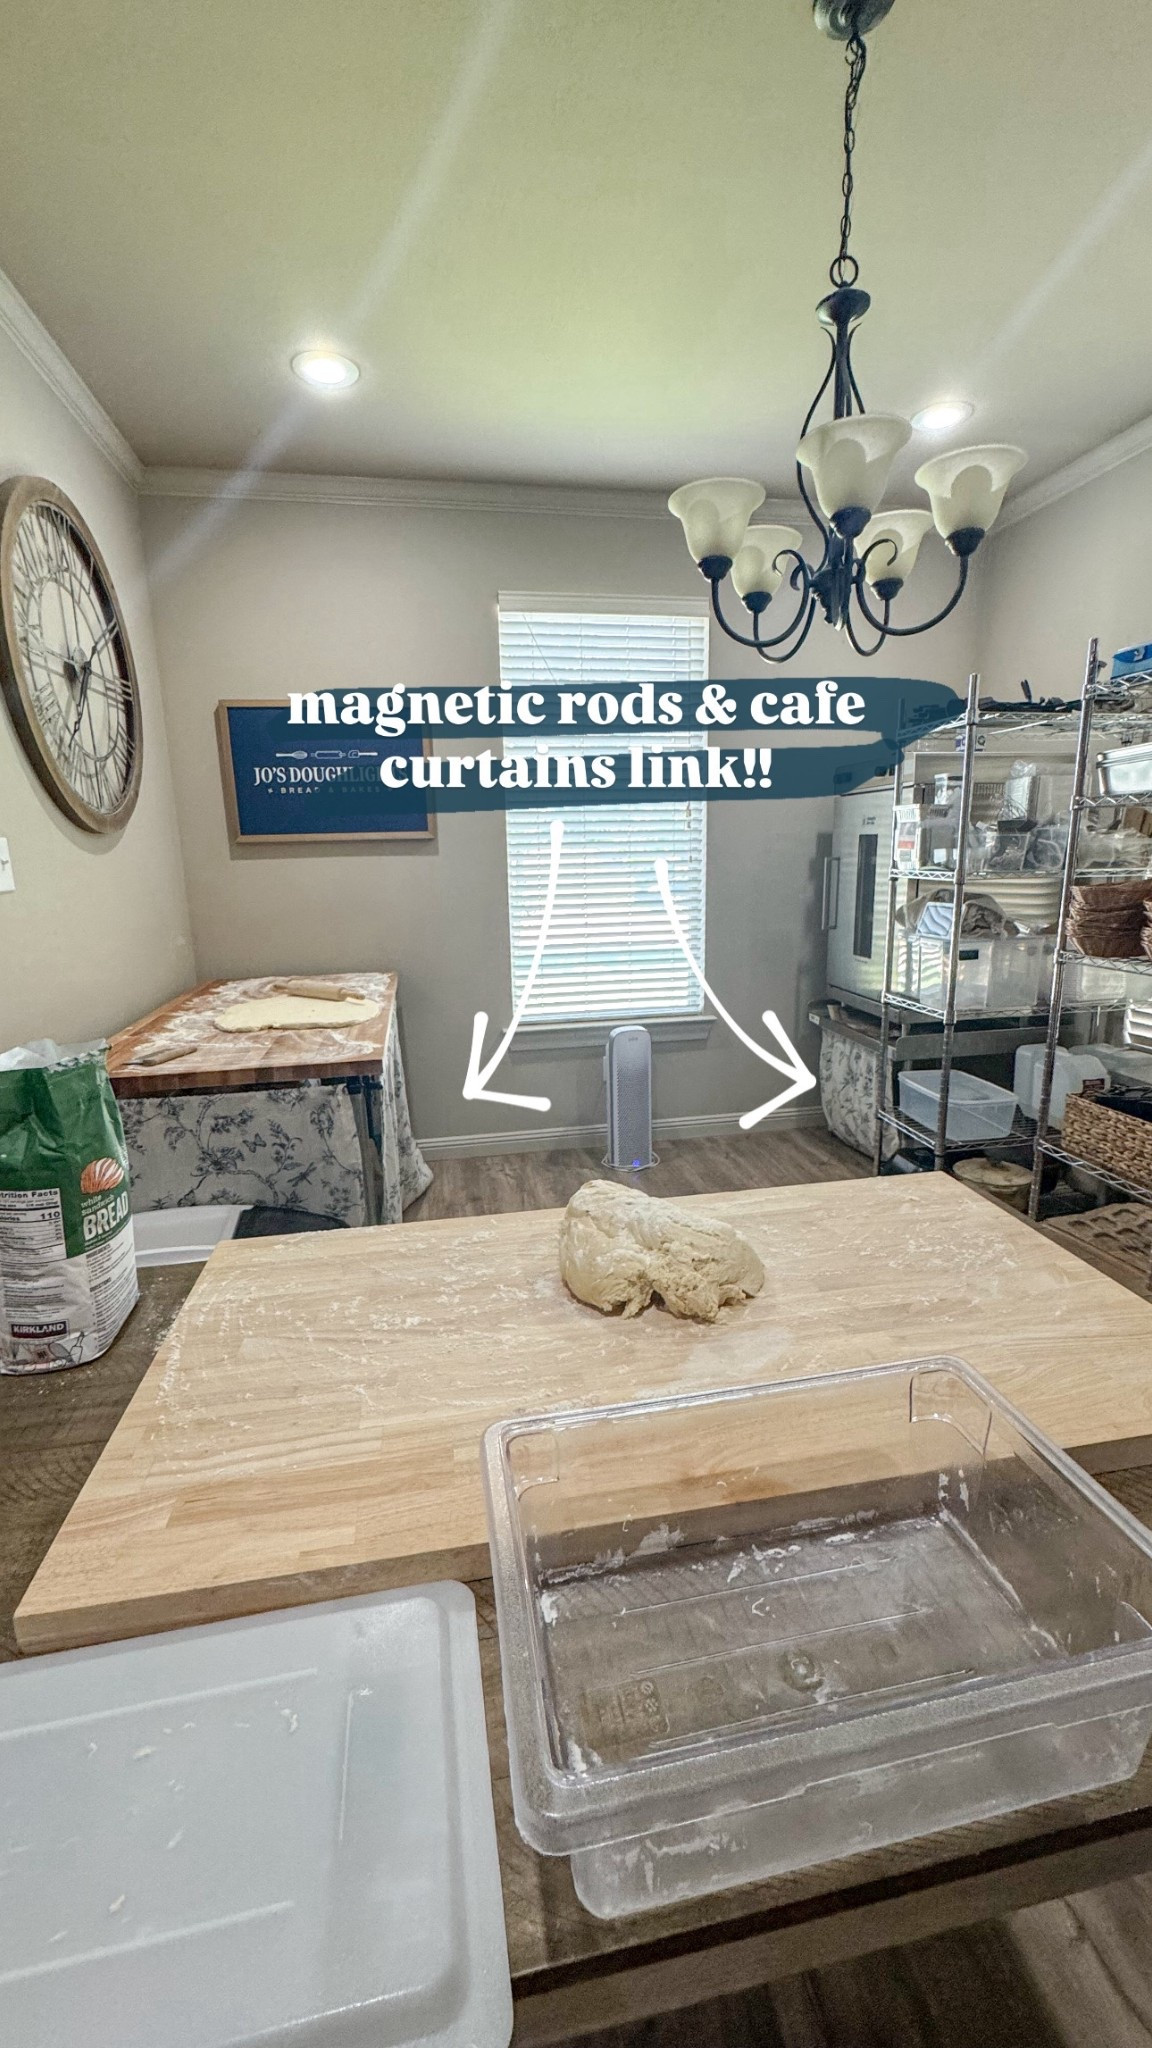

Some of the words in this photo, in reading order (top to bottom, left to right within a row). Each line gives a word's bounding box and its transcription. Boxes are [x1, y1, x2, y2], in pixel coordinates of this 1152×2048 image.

[253, 767, 287, 786] JO'S
[31, 1190, 58, 1198] Facts
[40, 1211, 60, 1220] 110
[83, 1190, 128, 1241] BREAD
[13, 1323, 65, 1334] KIRKLAND
